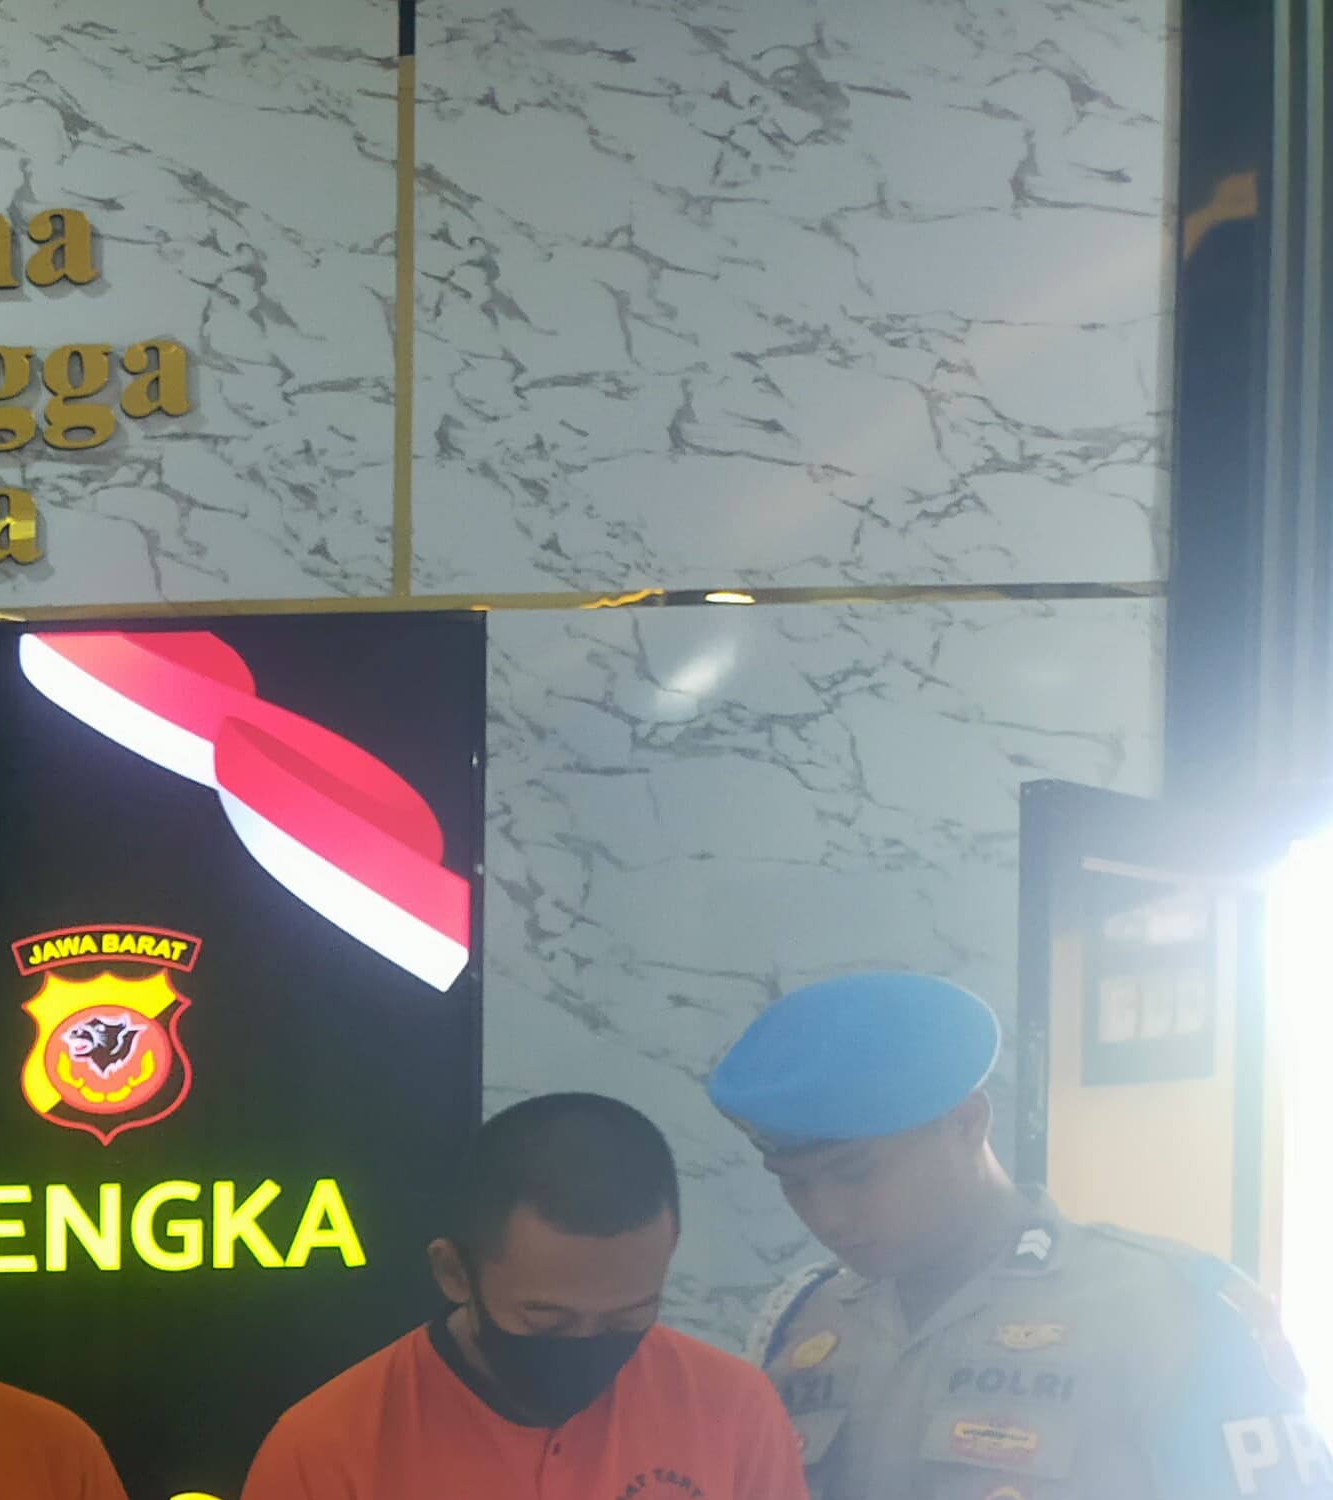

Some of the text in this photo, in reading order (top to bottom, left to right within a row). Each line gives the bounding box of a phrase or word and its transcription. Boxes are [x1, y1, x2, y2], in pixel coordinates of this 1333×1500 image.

[29, 933, 189, 965] JAWA BARAT
[948, 1367, 1076, 1402] POLRI
